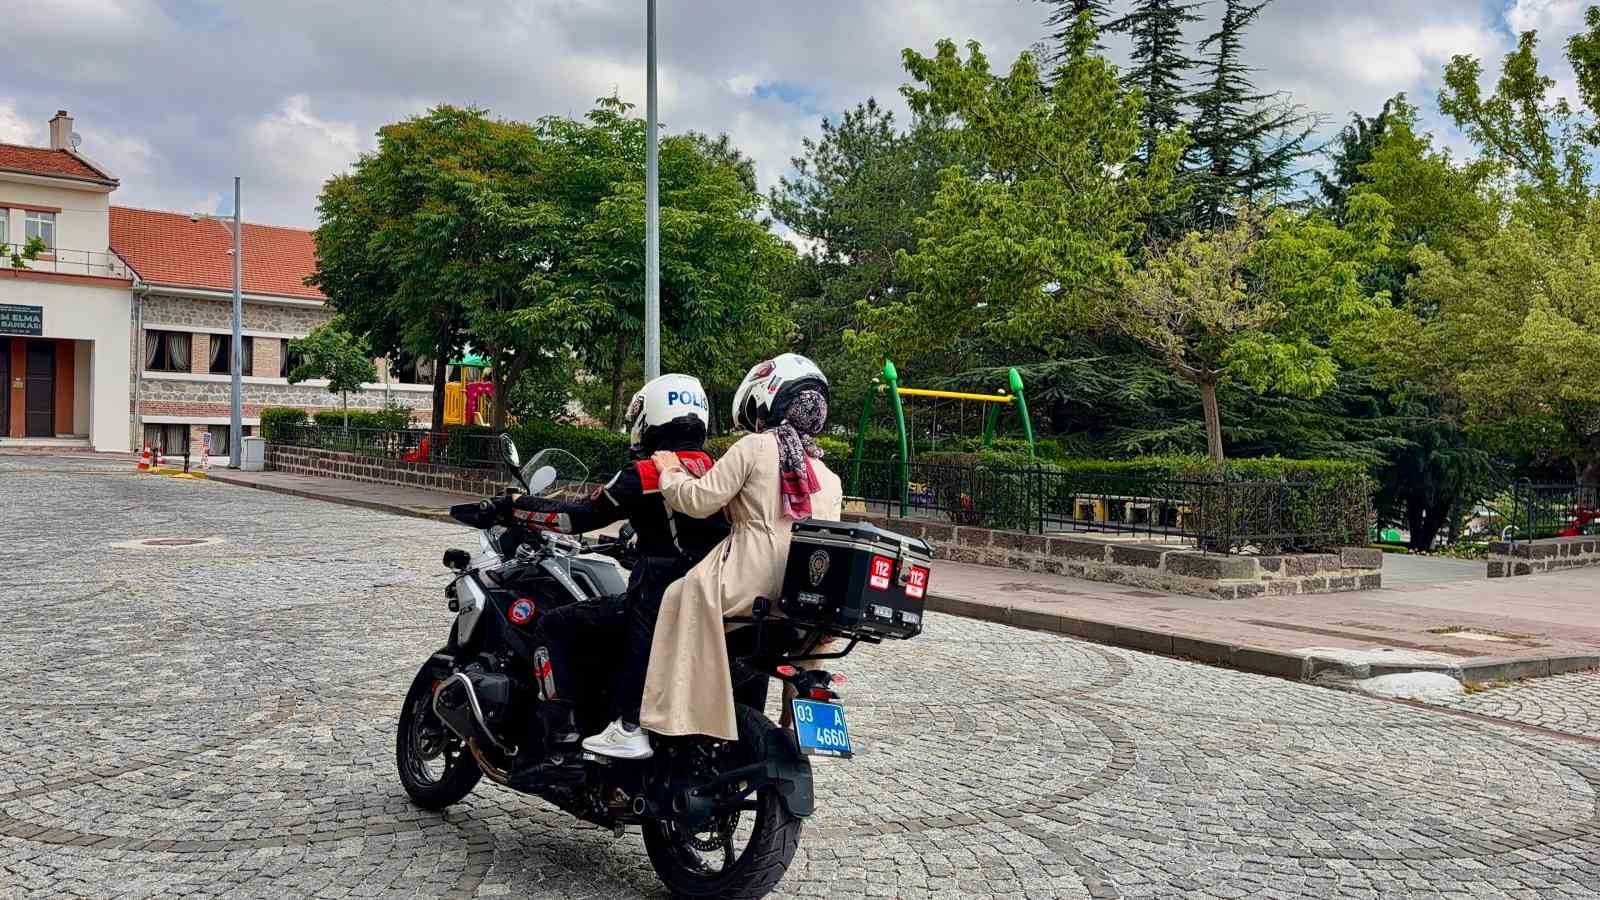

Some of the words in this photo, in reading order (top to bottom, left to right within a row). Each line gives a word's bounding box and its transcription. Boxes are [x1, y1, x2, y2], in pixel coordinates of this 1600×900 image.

[12, 314, 41, 322] ELMA
[876, 560, 890, 577] 112
[910, 570, 924, 586] 112
[797, 705, 813, 722] 03
[834, 709, 842, 726] A
[816, 727, 846, 746] 4660
